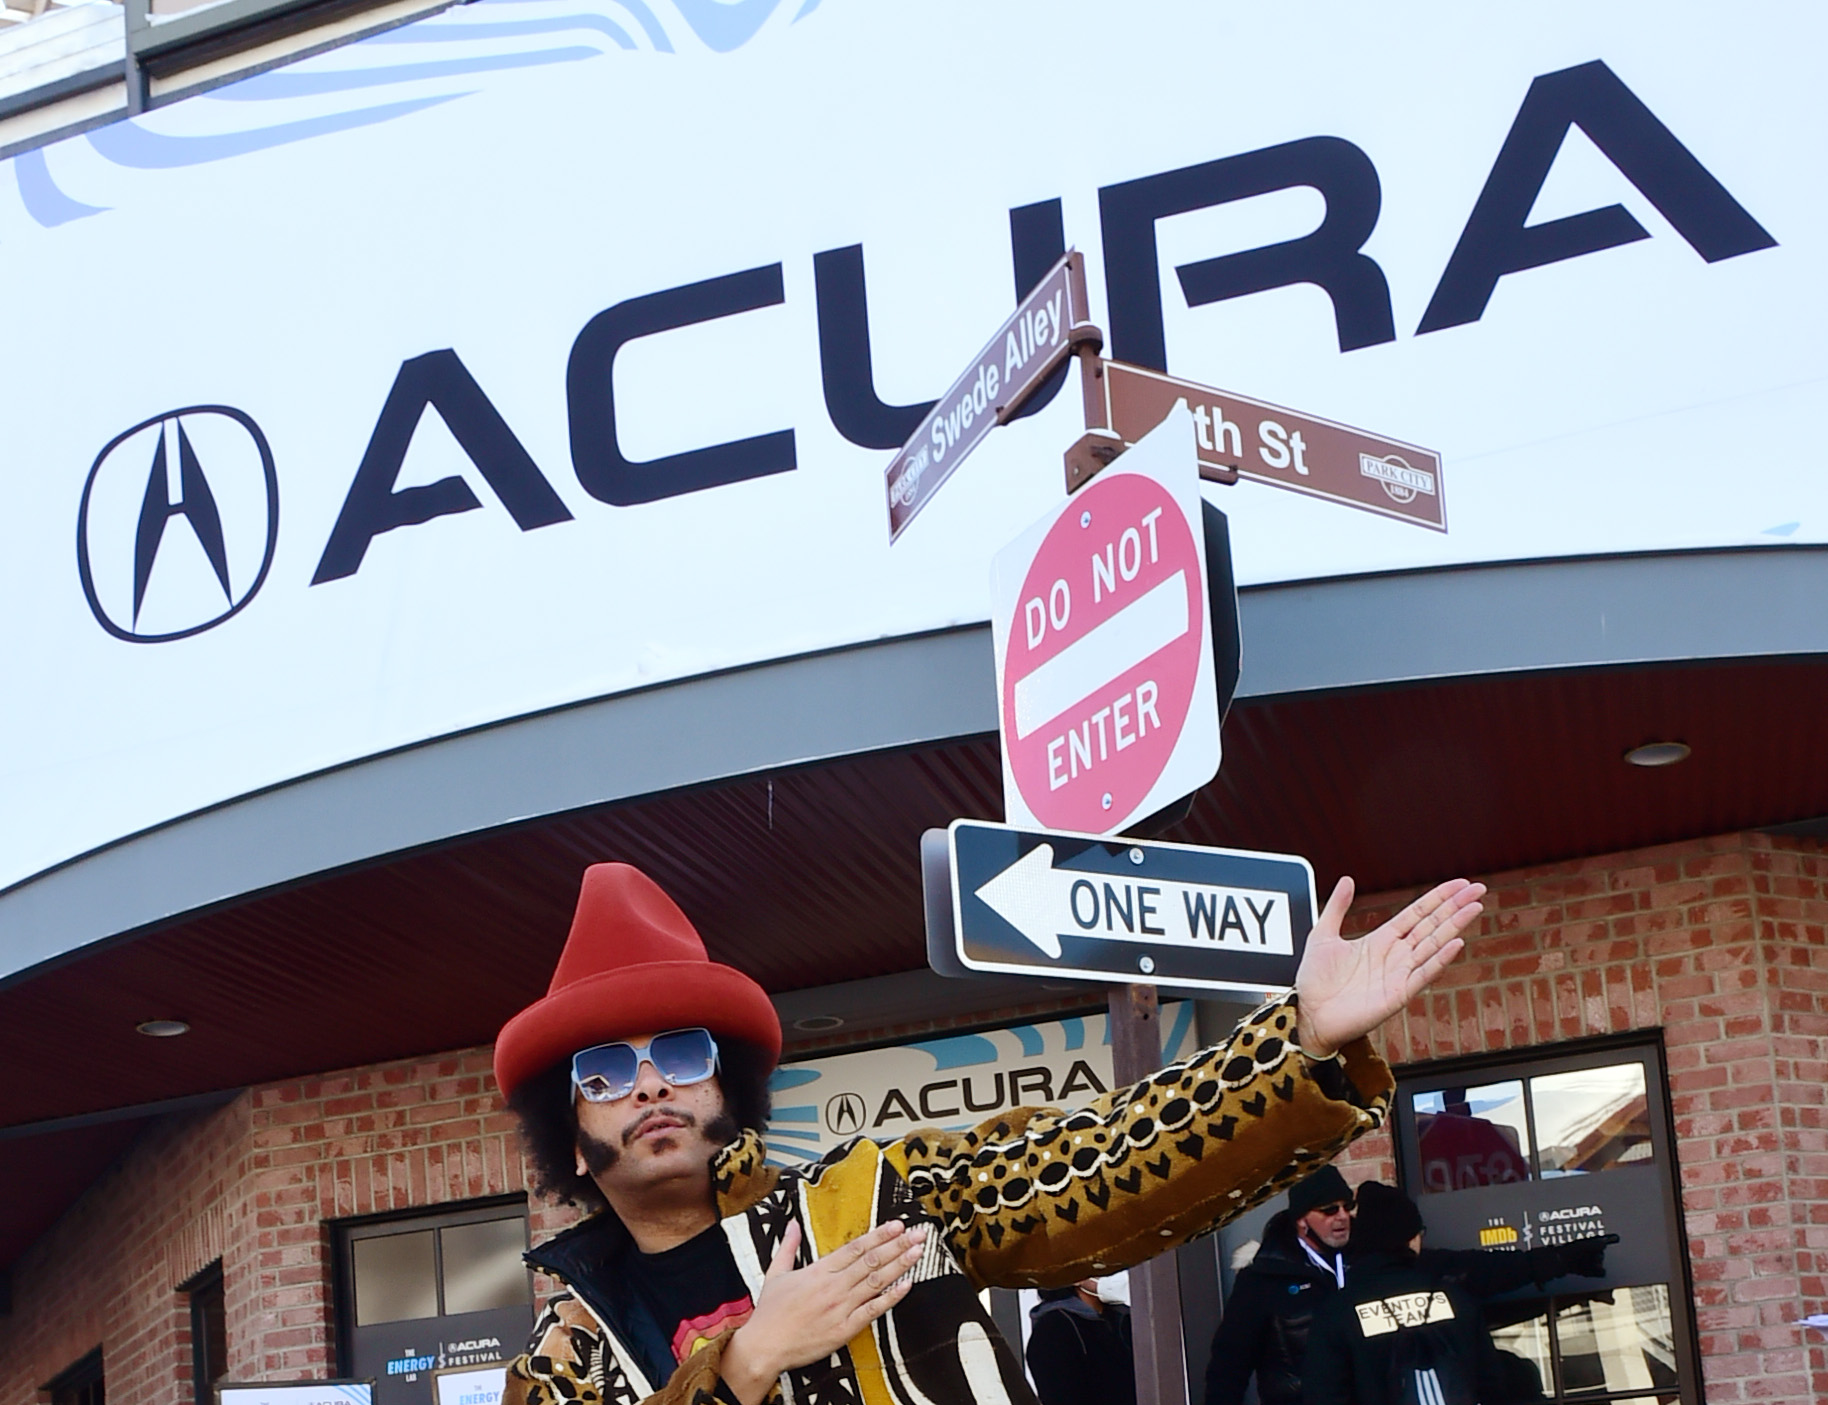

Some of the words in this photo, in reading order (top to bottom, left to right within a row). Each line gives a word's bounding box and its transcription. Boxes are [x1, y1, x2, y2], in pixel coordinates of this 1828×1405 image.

[309, 59, 1778, 586] ACURA
[930, 364, 1000, 464] Swede
[1004, 288, 1063, 384] Alley
[1176, 398, 1243, 458] th
[1258, 419, 1309, 476] St
[1366, 460, 1398, 480] PARK
[1400, 470, 1429, 488] CITY
[1024, 578, 1072, 652] DO
[1091, 506, 1163, 604] NOT
[1045, 679, 1162, 792] ENTER
[1069, 878, 1167, 936] ONE
[1181, 889, 1276, 946] WAY
[871, 1059, 1109, 1129] ACURA
[1549, 1205, 1603, 1221] ACURA
[1479, 1226, 1518, 1247] IMDb
[1540, 1219, 1605, 1237] FESTIVAL
[1359, 1299, 1411, 1320] EVENT
[1414, 1294, 1447, 1309] OS
[404, 1348, 416, 1358] THE
[456, 1337, 501, 1352] ACURA
[386, 1355, 436, 1376] ENERGY
[448, 1351, 503, 1367] FESTIVAL
[405, 1373, 417, 1383] LAB
